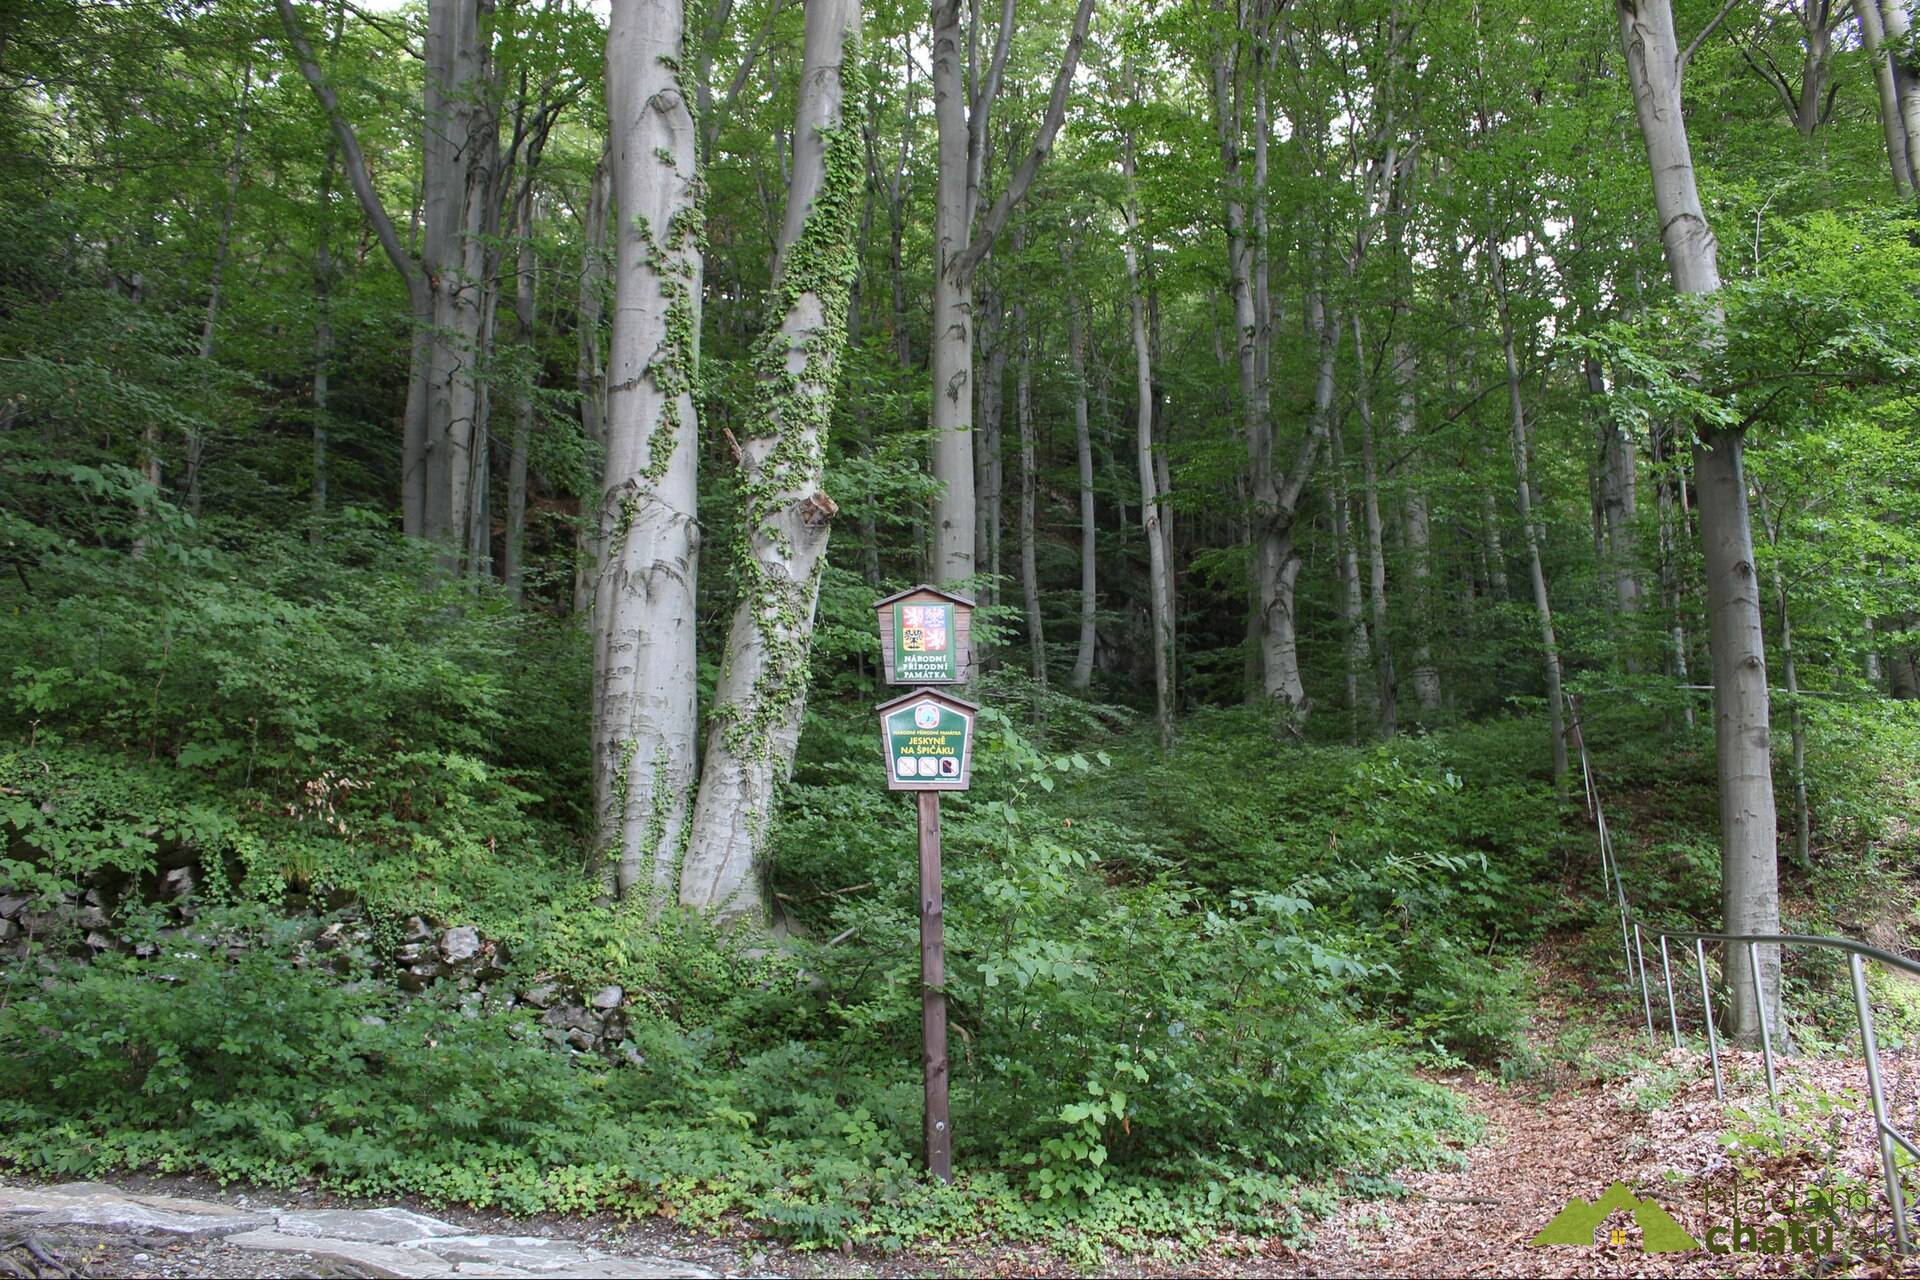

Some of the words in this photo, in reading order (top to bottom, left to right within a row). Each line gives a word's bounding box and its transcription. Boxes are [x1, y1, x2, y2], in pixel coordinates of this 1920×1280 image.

[904, 655, 946, 663] NÁRODNÍ
[903, 663, 948, 671] PŘÍRODNÍ
[904, 671, 947, 679] PAMÁTKA
[916, 745, 954, 755] ŠPIČÁKU
